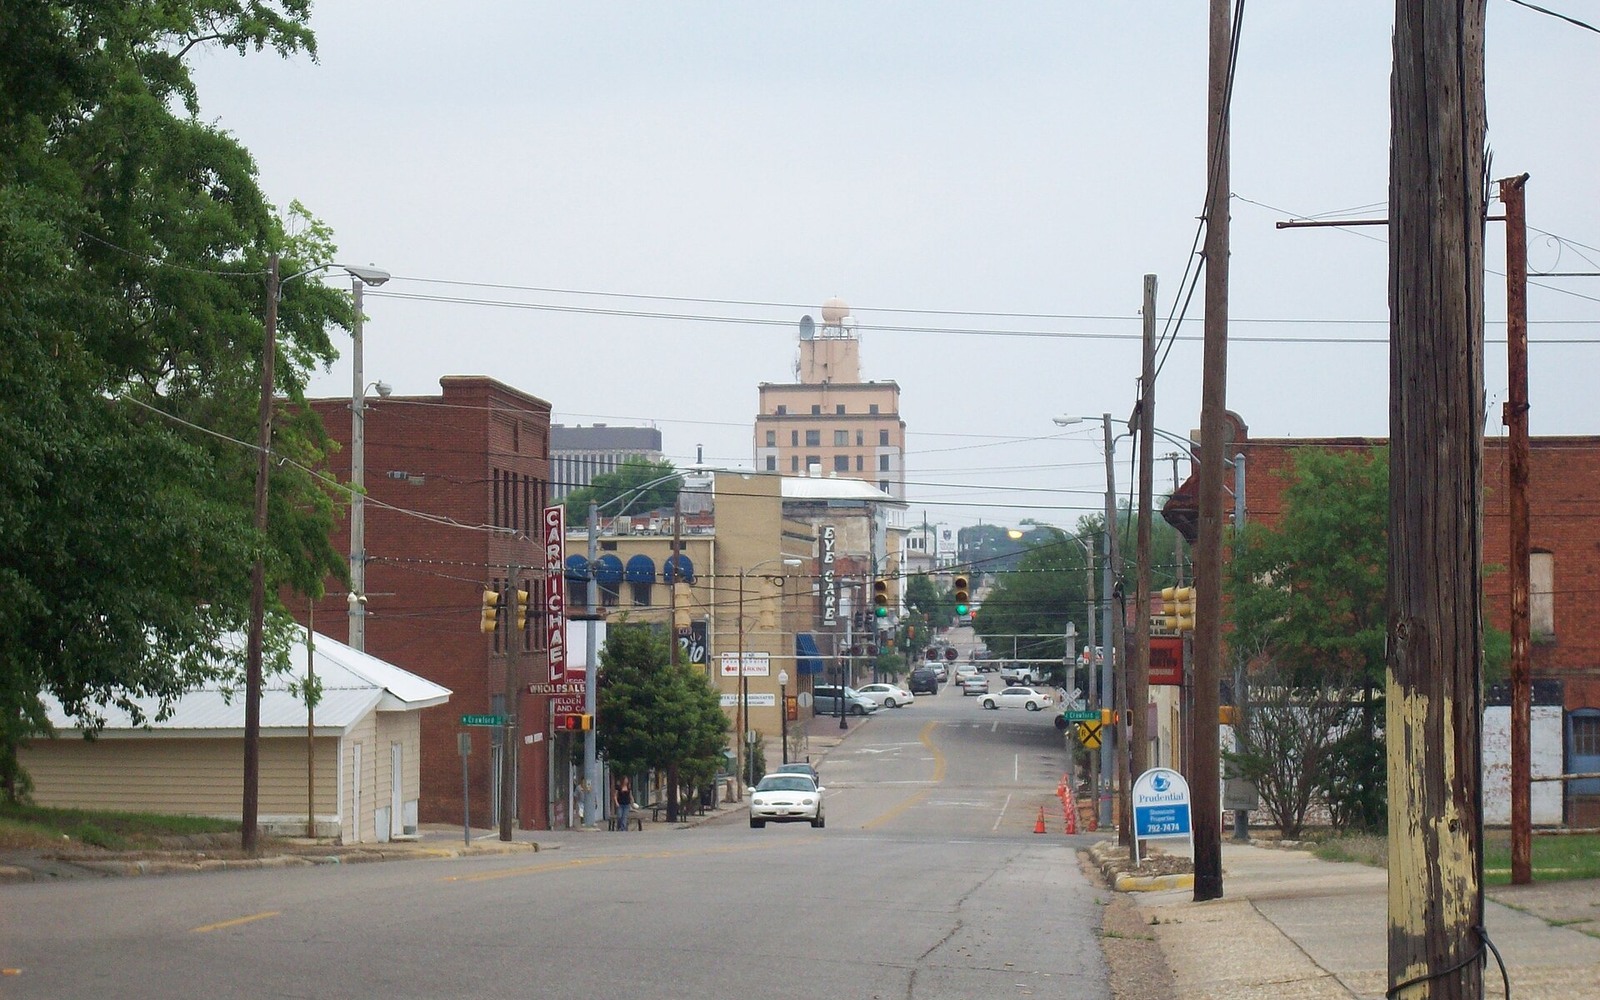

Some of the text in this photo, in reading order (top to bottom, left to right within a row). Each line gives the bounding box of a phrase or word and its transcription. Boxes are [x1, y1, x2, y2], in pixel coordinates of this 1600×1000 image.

[824, 526, 836, 620] EYE CARE
[546, 510, 563, 681] CARMICHAEL
[529, 684, 585, 693] WHOLESALE
[1081, 729, 1087, 737] R
[1139, 792, 1184, 803] Prudential
[1147, 823, 1180, 833] 792-7474
